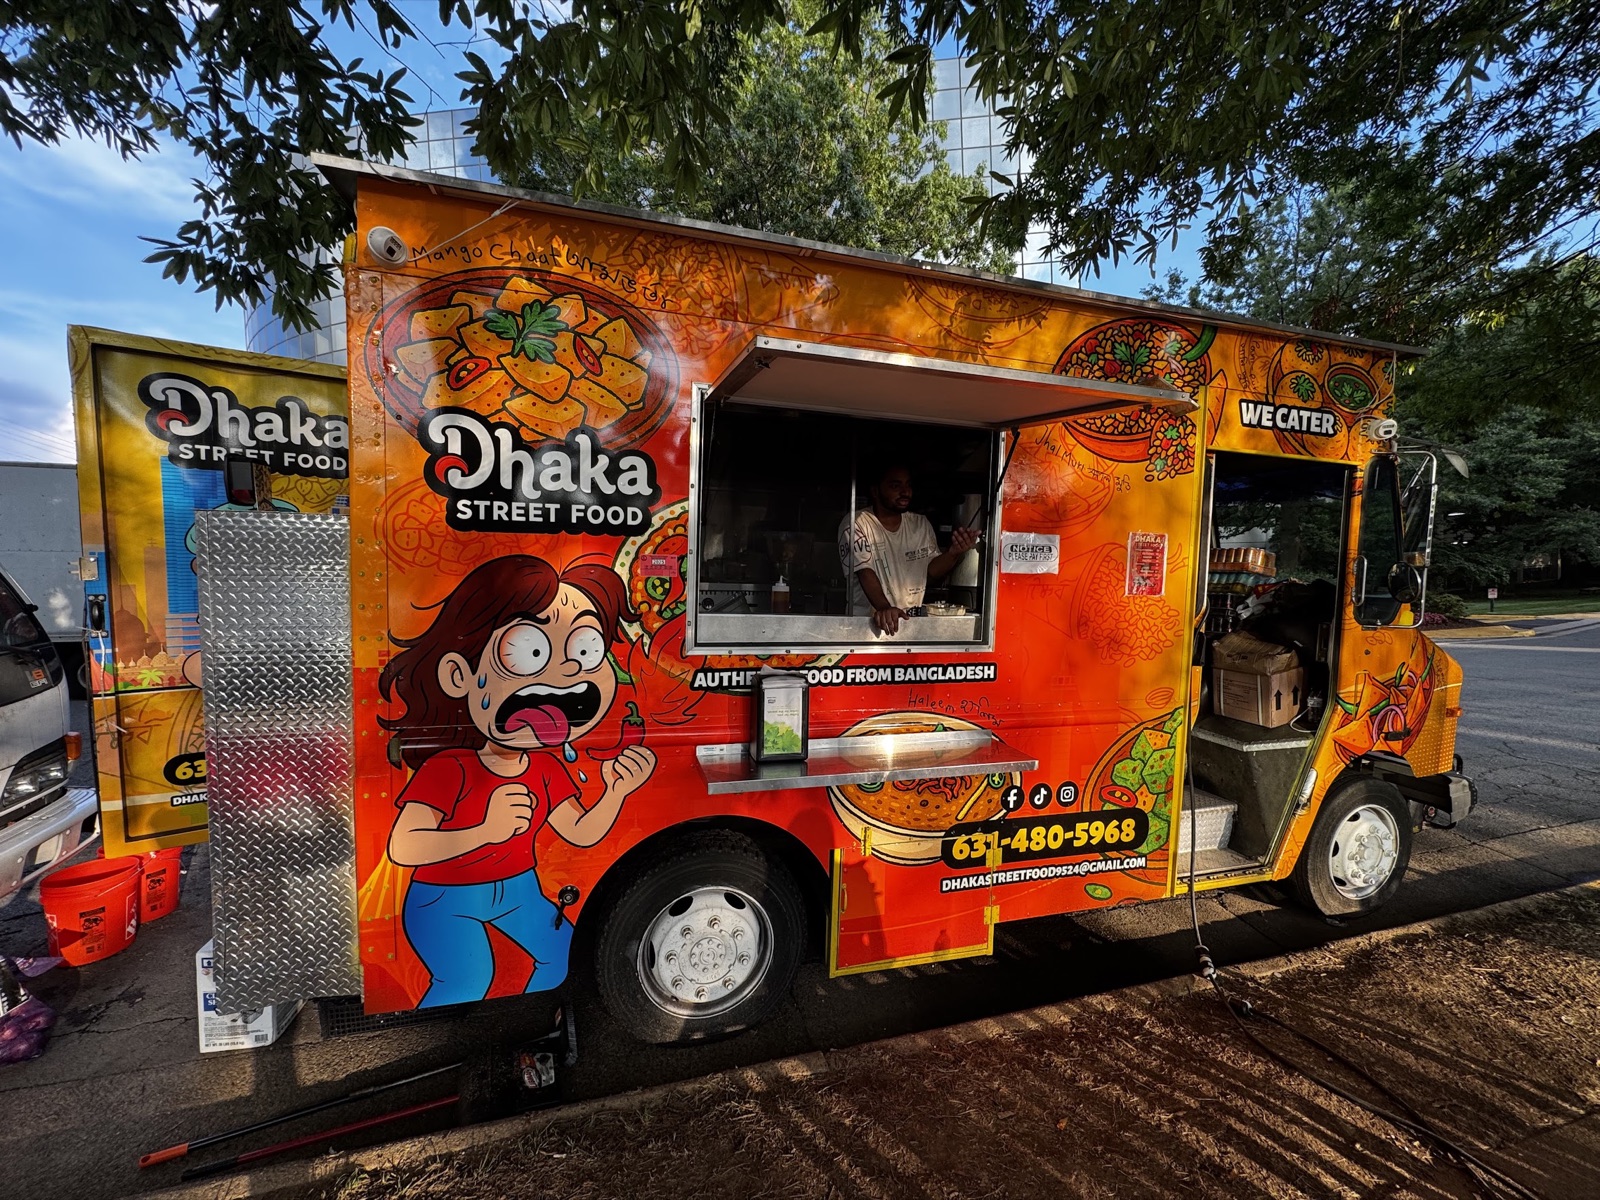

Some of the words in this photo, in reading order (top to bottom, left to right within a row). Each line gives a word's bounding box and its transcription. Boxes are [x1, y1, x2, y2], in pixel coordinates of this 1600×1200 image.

[408, 245, 482, 268] Mango
[490, 240, 560, 266] Chaat
[149, 378, 349, 449] Dhaka
[1241, 402, 1274, 428] WE
[1275, 407, 1335, 435] CATER
[283, 452, 348, 471] FOOD
[428, 413, 653, 500] Dhaka
[456, 500, 561, 523] STREET
[571, 504, 643, 526] FOOD
[1012, 545, 1052, 553] NOTICE
[847, 667, 892, 682] FROM
[895, 665, 995, 682] BANGLADESH
[907, 688, 956, 714] Haleem
[952, 818, 1136, 860] 631-480-5968
